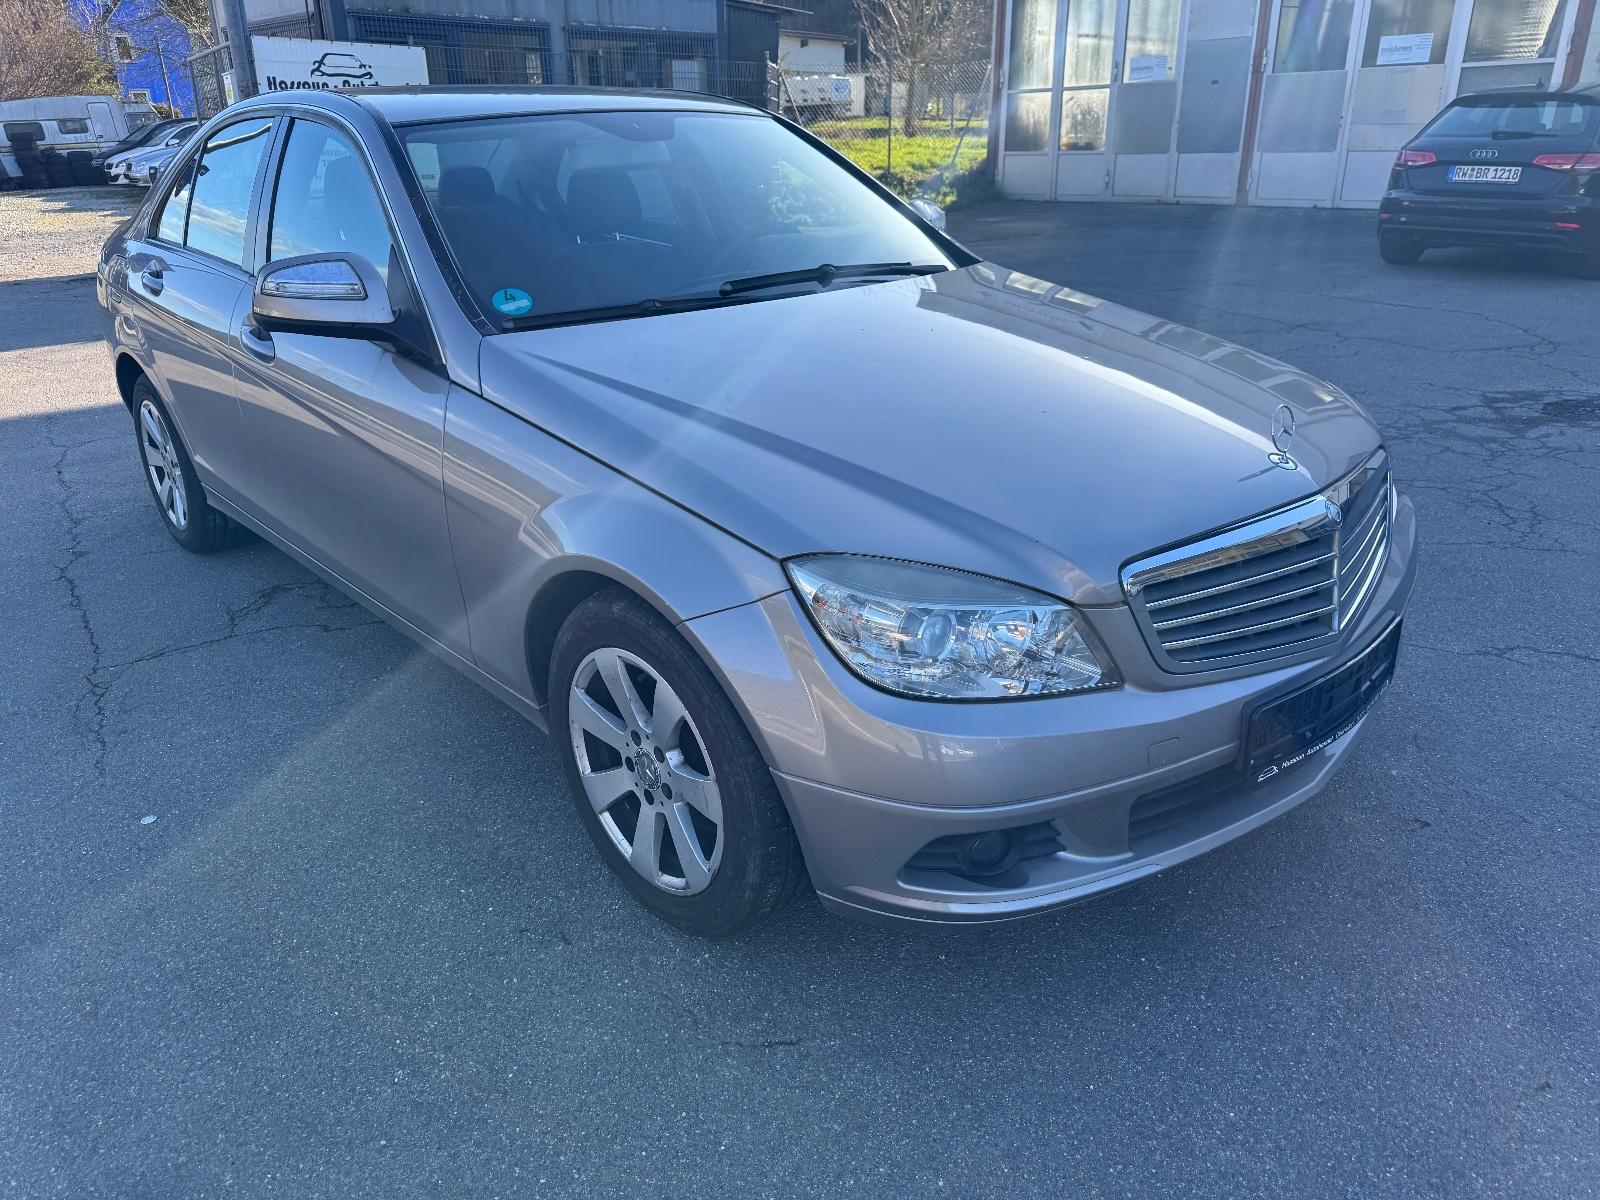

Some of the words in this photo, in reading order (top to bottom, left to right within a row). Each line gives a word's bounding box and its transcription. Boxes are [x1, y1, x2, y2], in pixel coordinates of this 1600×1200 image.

[1454, 166, 1469, 179] RW
[1475, 167, 1490, 179] BR
[1491, 168, 1520, 180] 1218
[503, 289, 517, 303] 4
